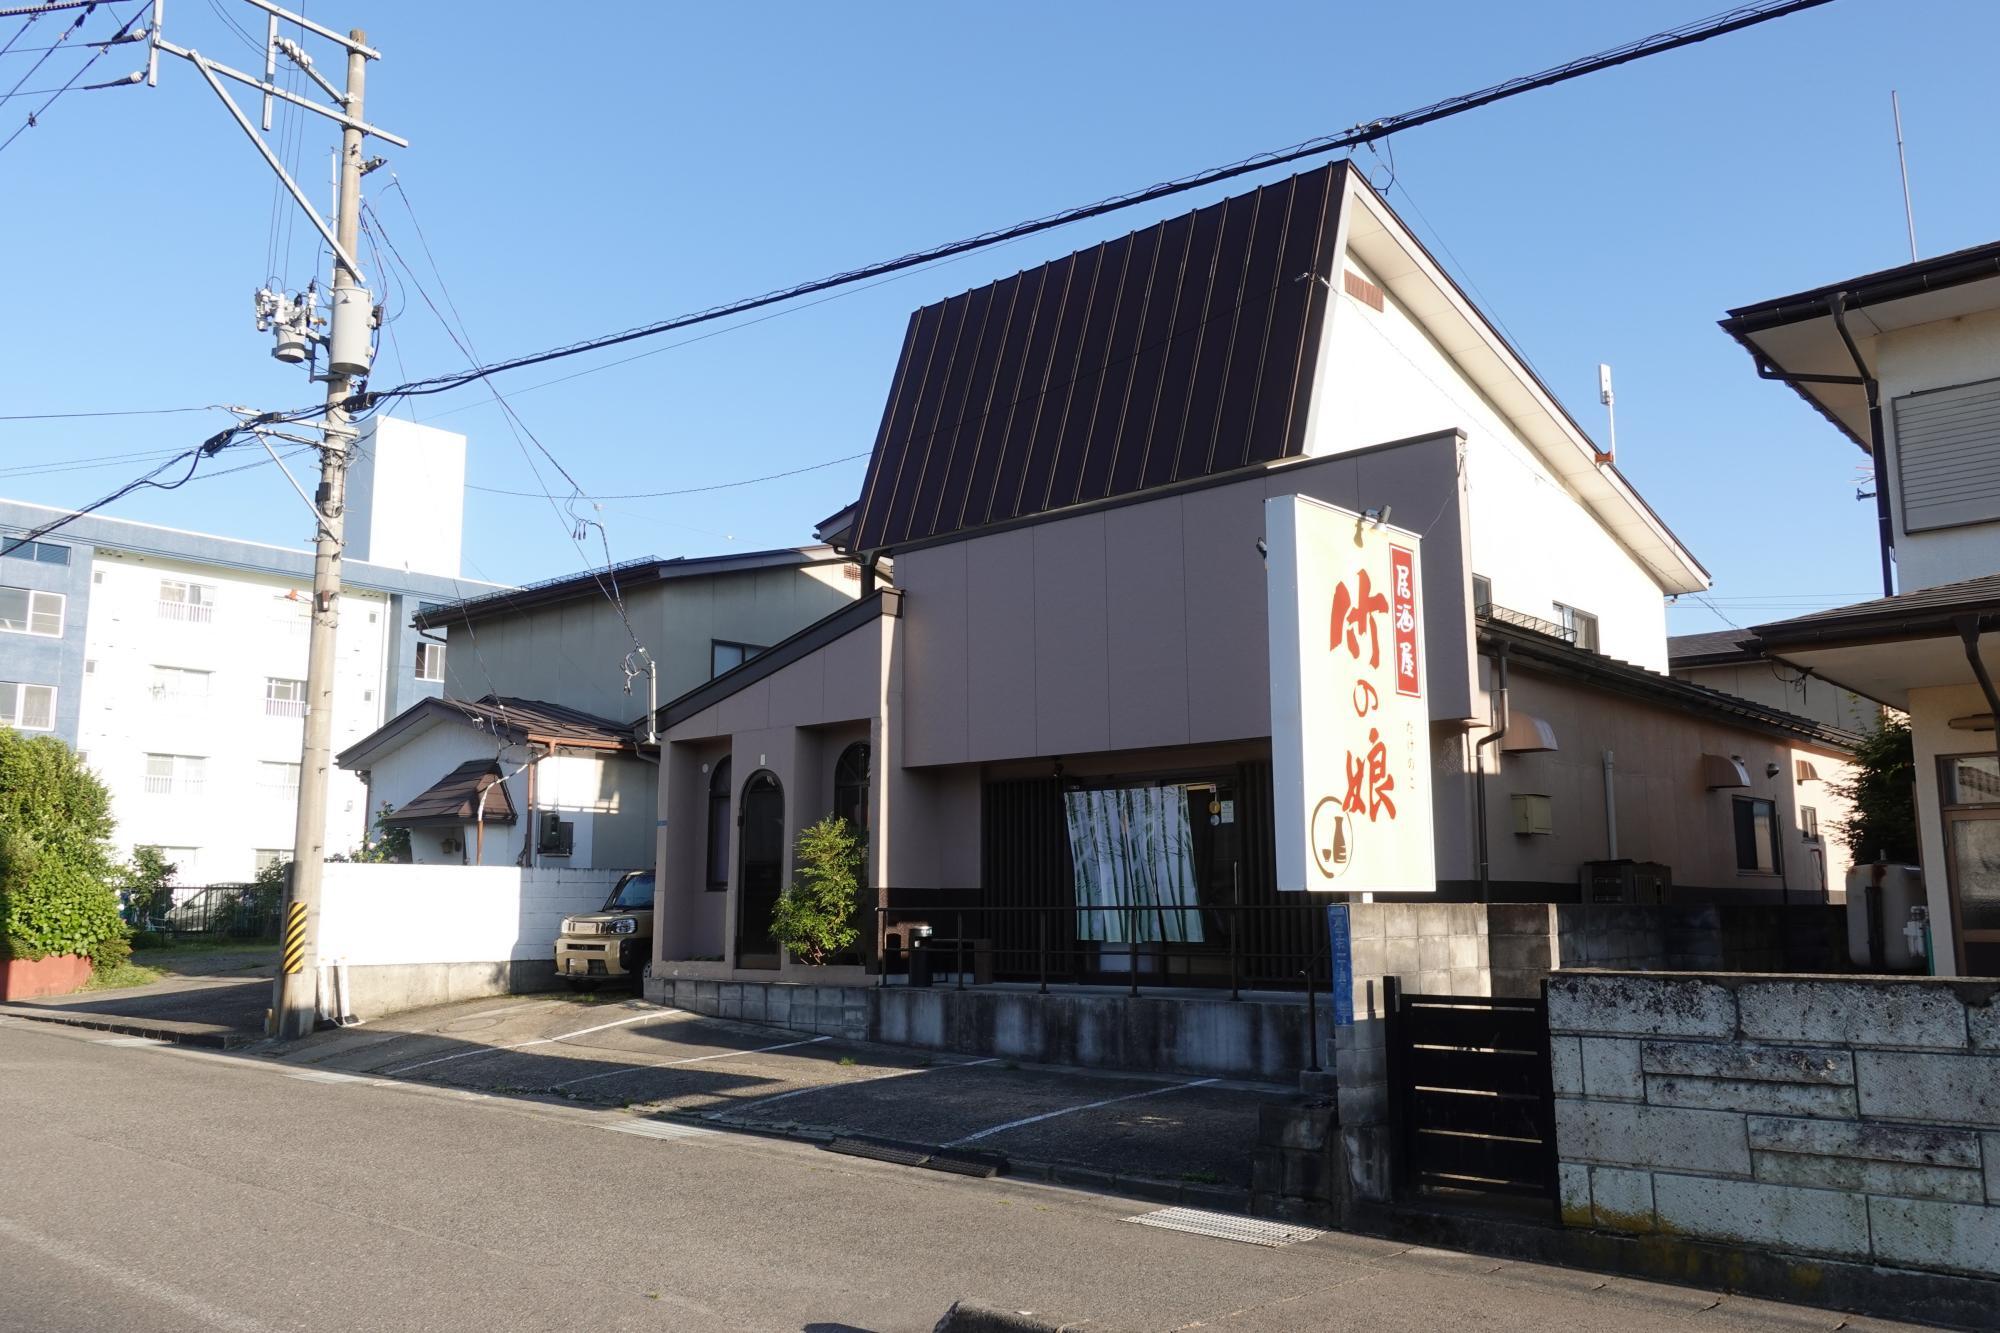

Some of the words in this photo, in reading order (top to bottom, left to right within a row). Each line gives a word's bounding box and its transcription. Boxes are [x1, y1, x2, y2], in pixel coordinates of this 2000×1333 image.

[1396, 565, 1415, 677] 居酒屋
[1330, 568, 1397, 822] 竹の娘
[1406, 720, 1415, 790] たけのこ
